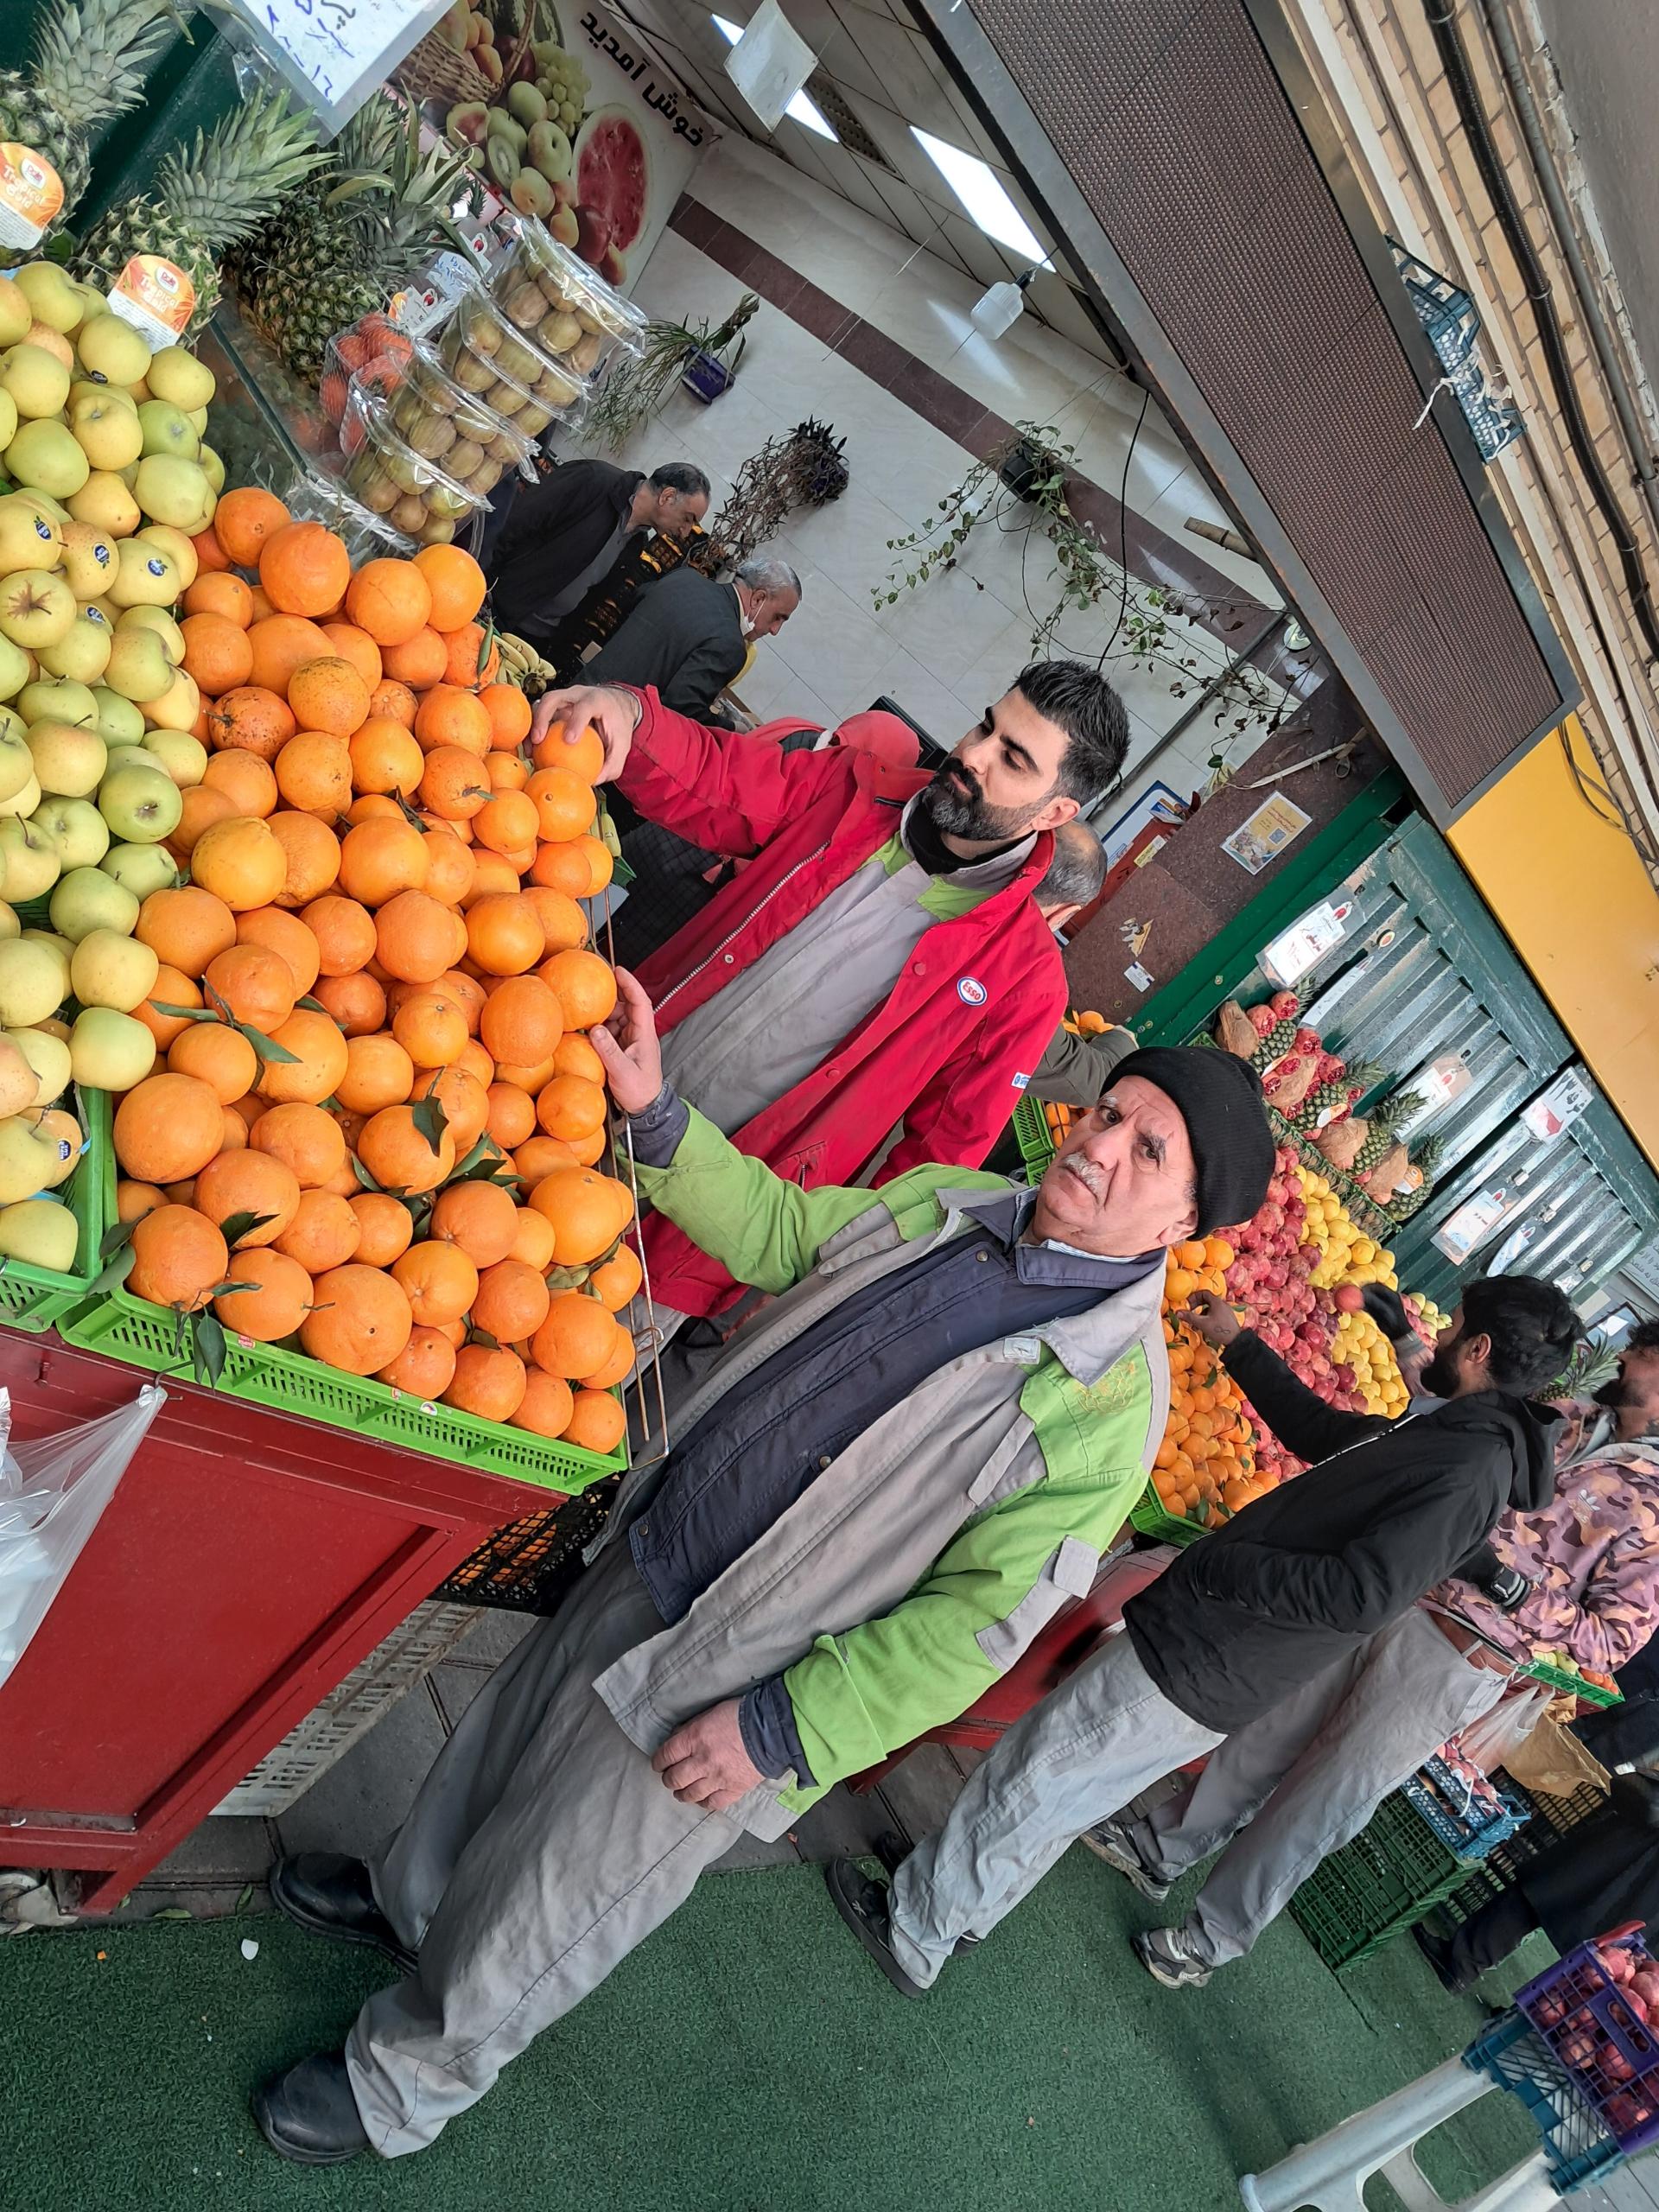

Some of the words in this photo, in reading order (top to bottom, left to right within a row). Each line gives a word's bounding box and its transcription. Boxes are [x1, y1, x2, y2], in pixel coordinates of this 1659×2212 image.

[580, 12, 651, 81] آمدید
[642, 81, 703, 147] خوش
[3, 164, 47, 207] Tropical
[140, 273, 181, 308] Tropical
